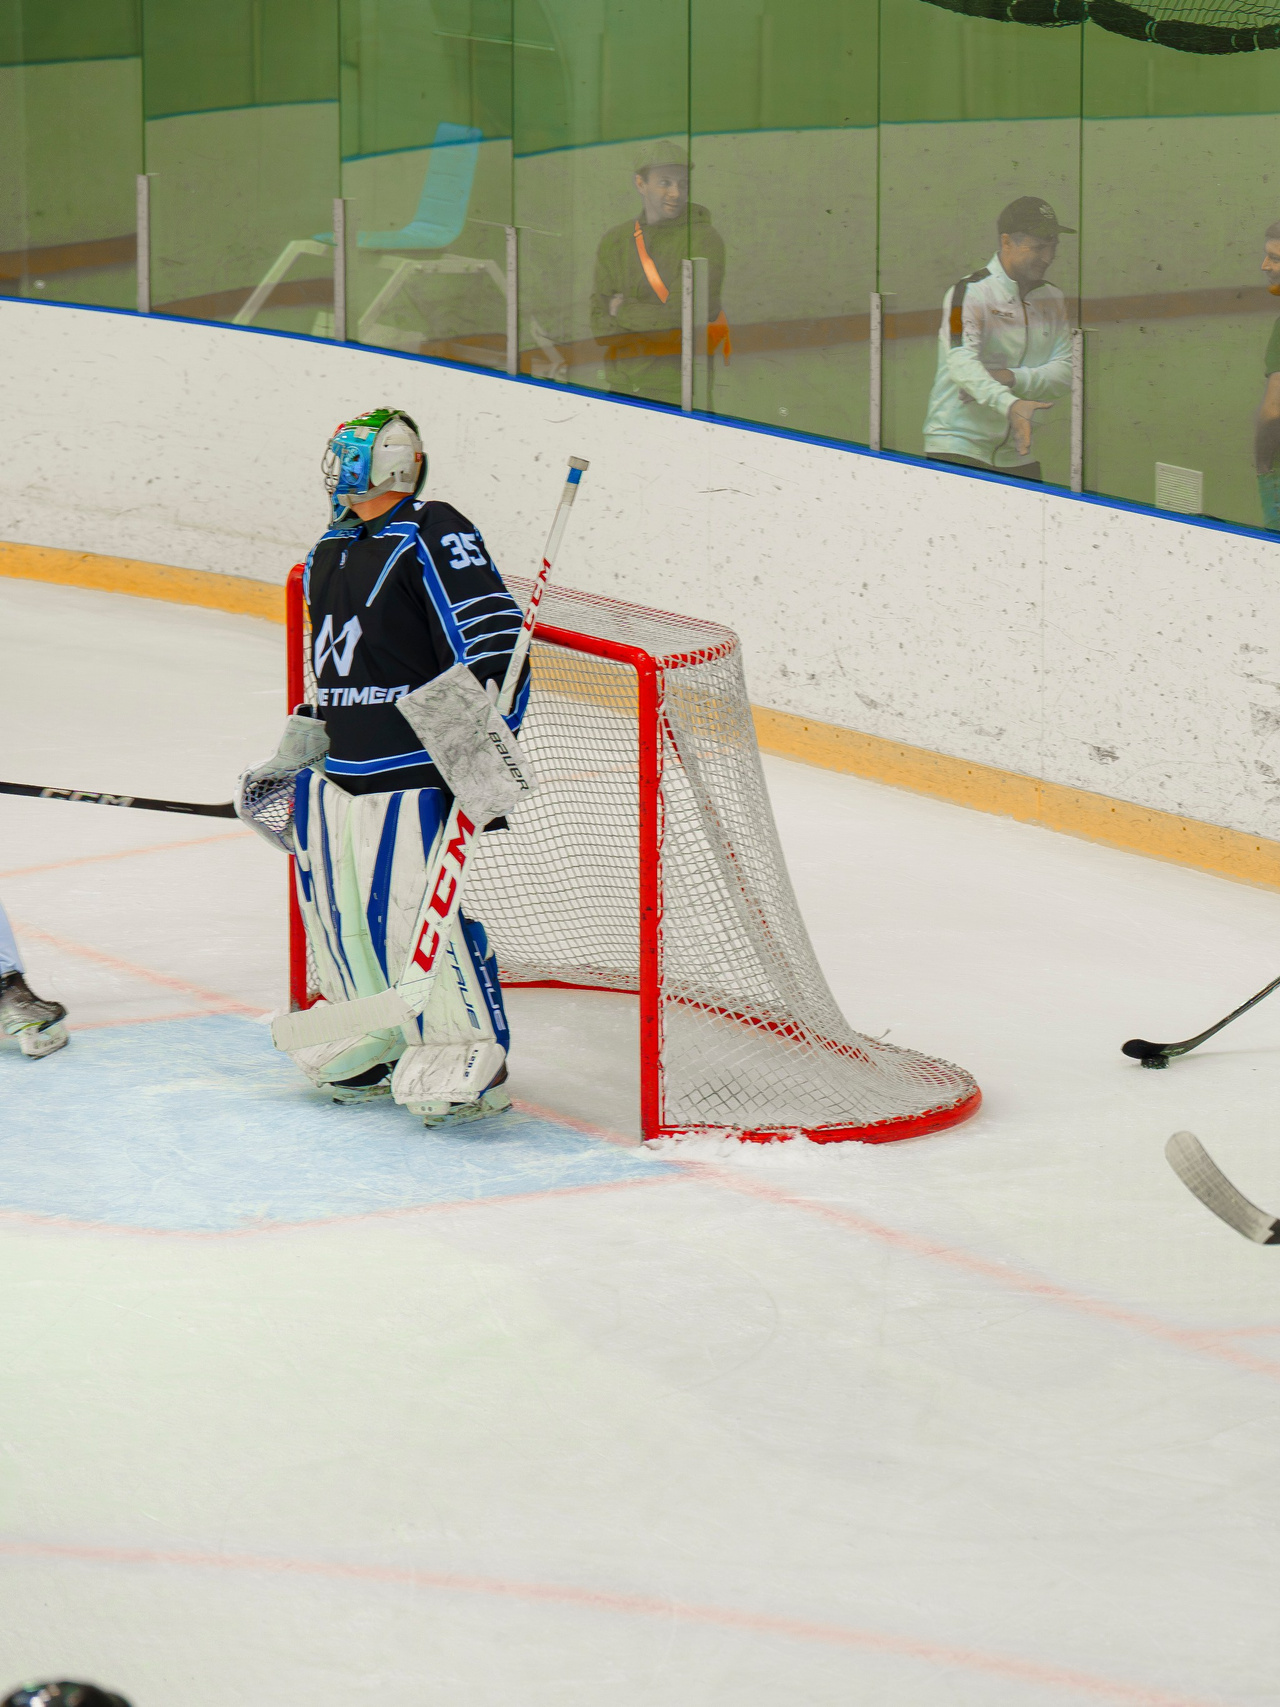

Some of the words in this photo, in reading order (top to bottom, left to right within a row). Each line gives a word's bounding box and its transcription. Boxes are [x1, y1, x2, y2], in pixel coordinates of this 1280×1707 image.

[440, 533, 487, 569] 35
[523, 557, 551, 632] CCM
[488, 731, 529, 791] BAUER
[411, 809, 476, 973] CCM
